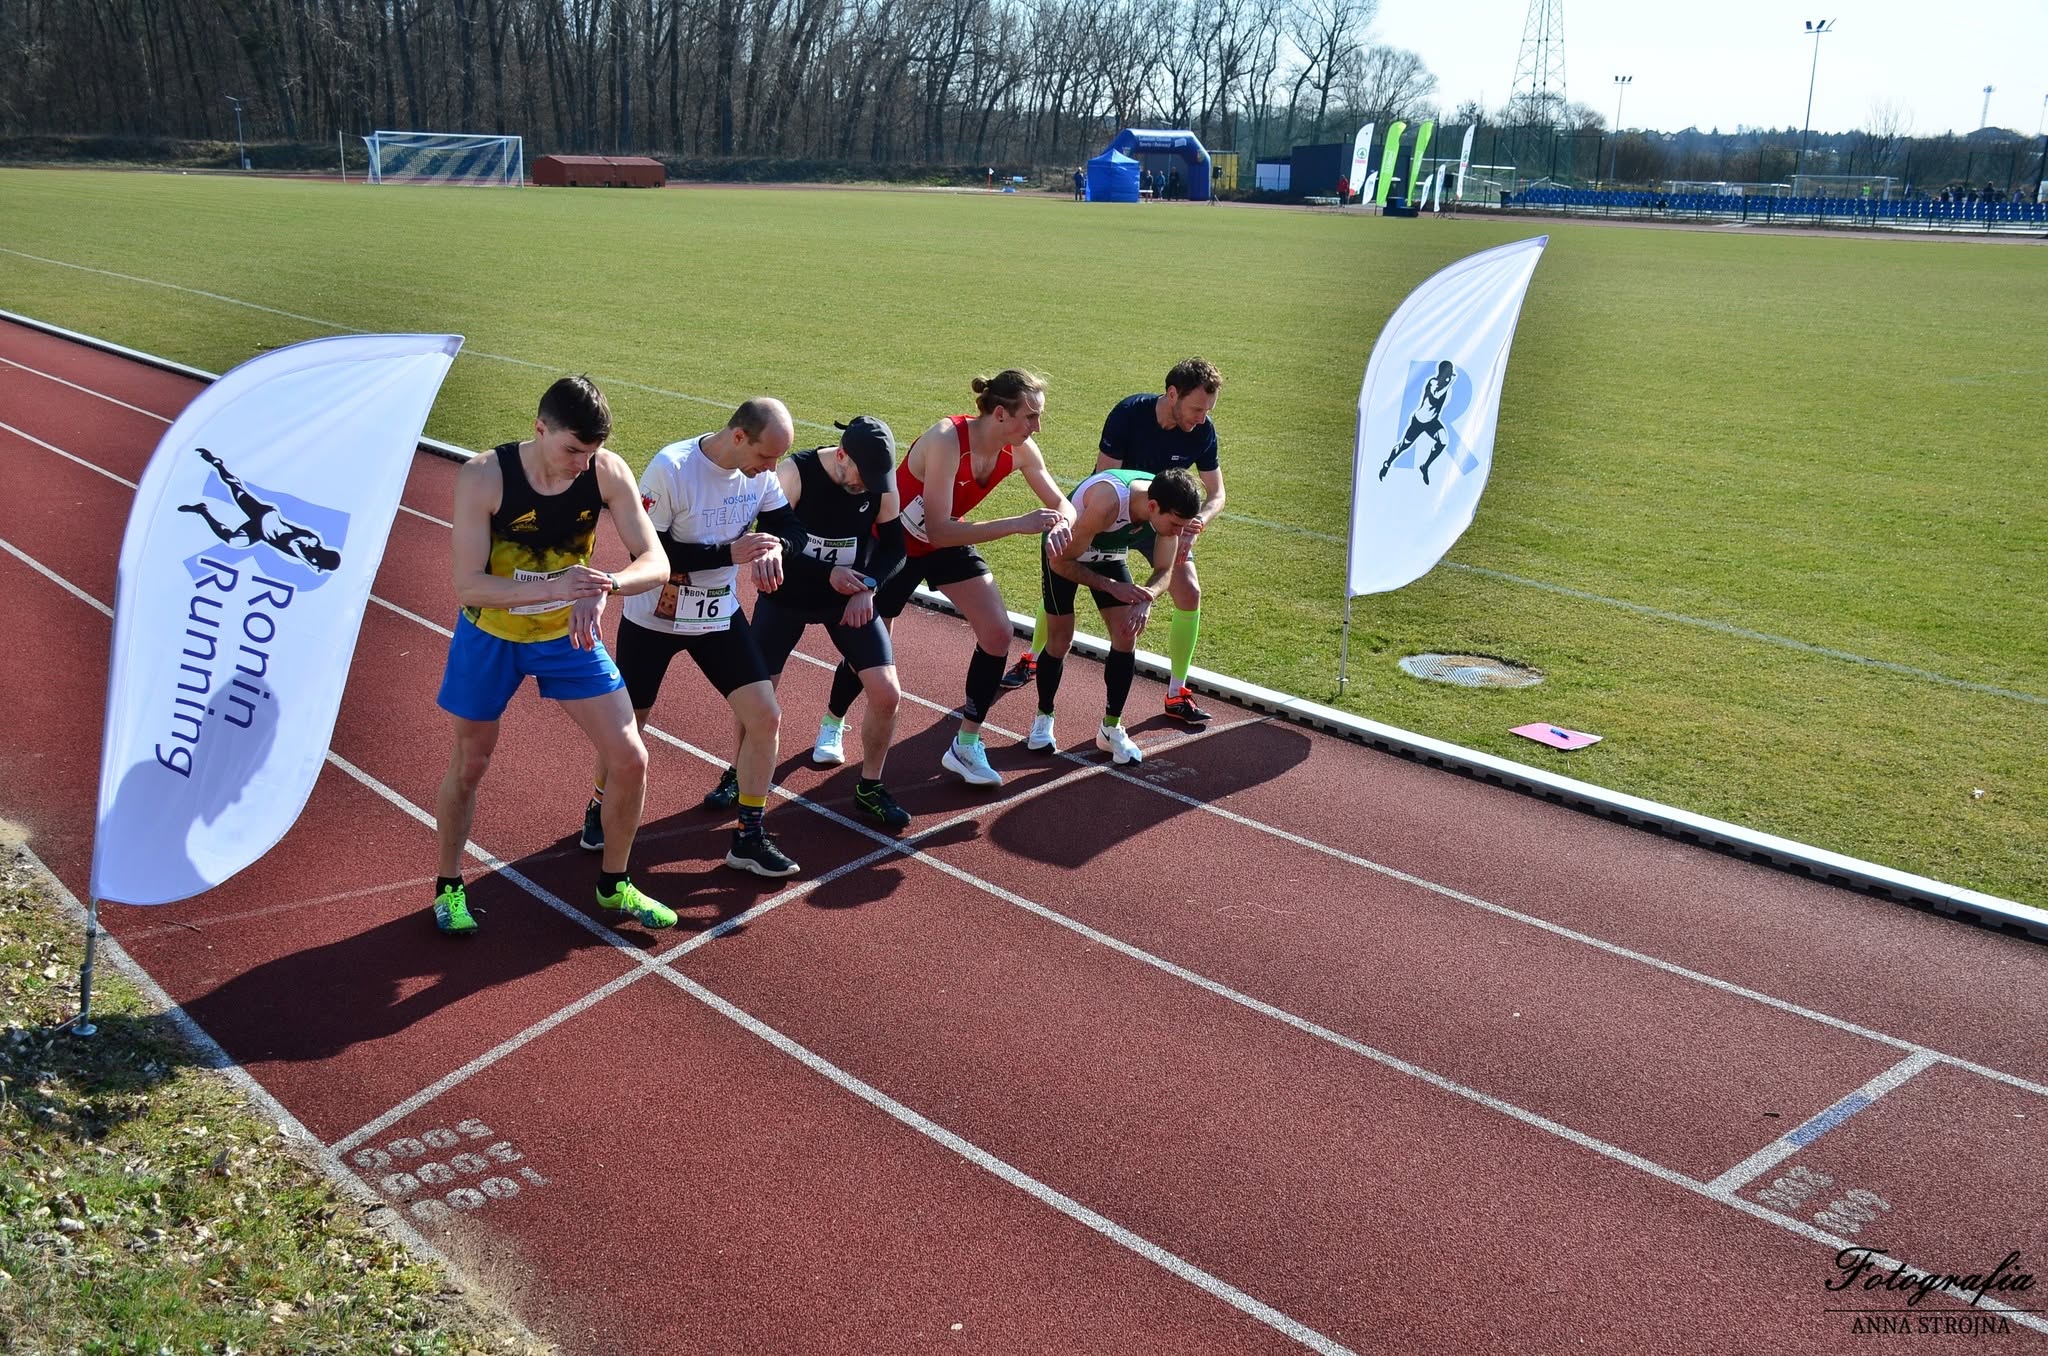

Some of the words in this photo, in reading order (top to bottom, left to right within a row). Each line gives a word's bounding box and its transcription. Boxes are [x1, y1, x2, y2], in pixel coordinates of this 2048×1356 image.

[702, 502, 758, 528] TEAM
[813, 547, 838, 565] 14
[696, 599, 719, 618] 16
[155, 558, 239, 778] Running
[233, 575, 294, 729] Ronin
[353, 1117, 495, 1170] 5000
